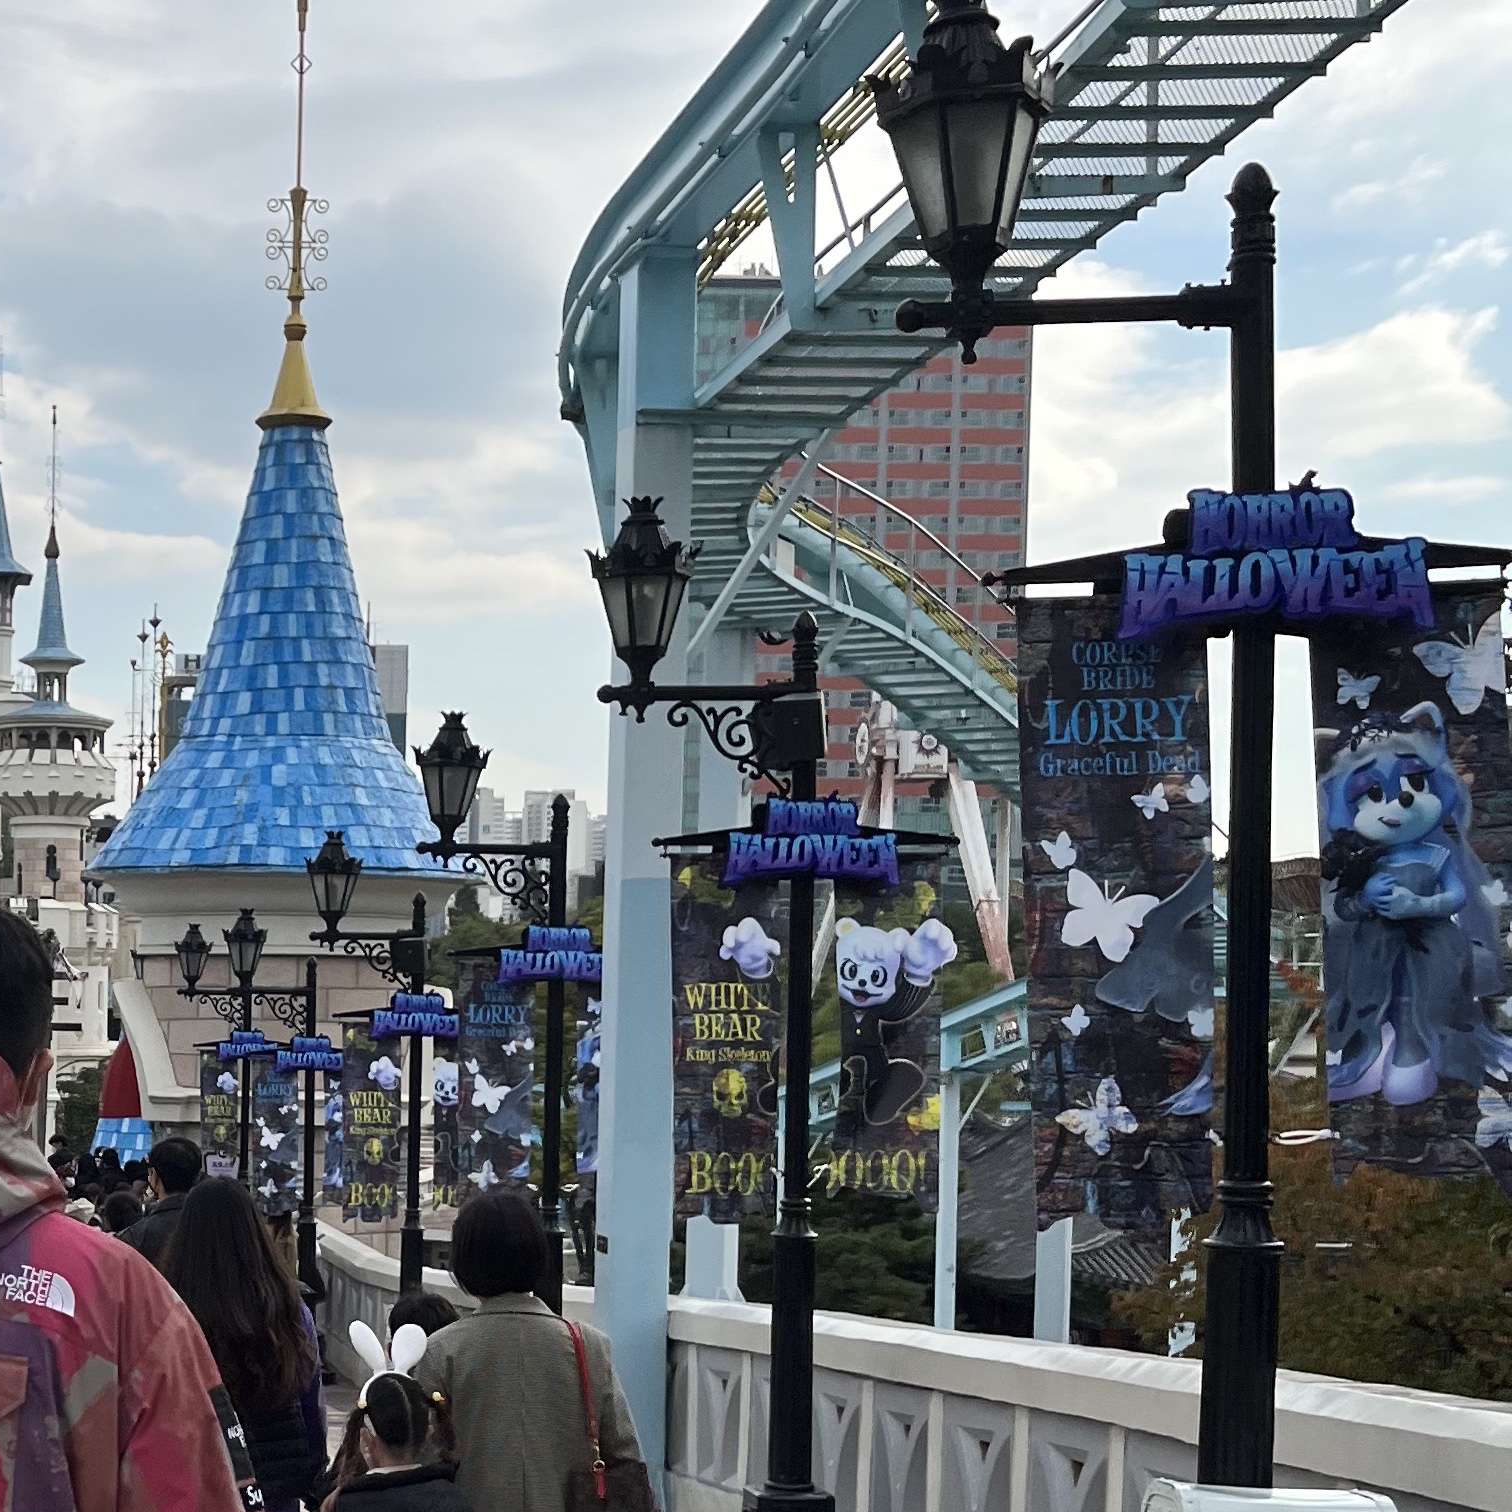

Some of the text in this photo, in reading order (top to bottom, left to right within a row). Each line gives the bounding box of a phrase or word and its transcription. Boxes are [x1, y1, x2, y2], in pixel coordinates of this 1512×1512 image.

[1190, 490, 1360, 556] HORROR
[1118, 538, 1436, 639] HALLOWEEN
[184, 654, 201, 669] H
[1072, 641, 1162, 666] CORPSE
[1080, 665, 1156, 691] BRIDE
[1044, 695, 1194, 746] LORRY
[1040, 749, 1203, 777] Graceful Dead
[766, 798, 861, 836] HORROR
[723, 832, 900, 886] HALLOWEEN
[528, 925, 593, 952] HORROR
[468, 1003, 529, 1024] LORRY
[693, 1013, 762, 1041] BEAR
[685, 1048, 716, 1063] King
[353, 1108, 392, 1124] BEAR
[21, 1264, 53, 1282] THE
[6, 1287, 48, 1306] FACE
[247, 1485, 265, 1507] Su
